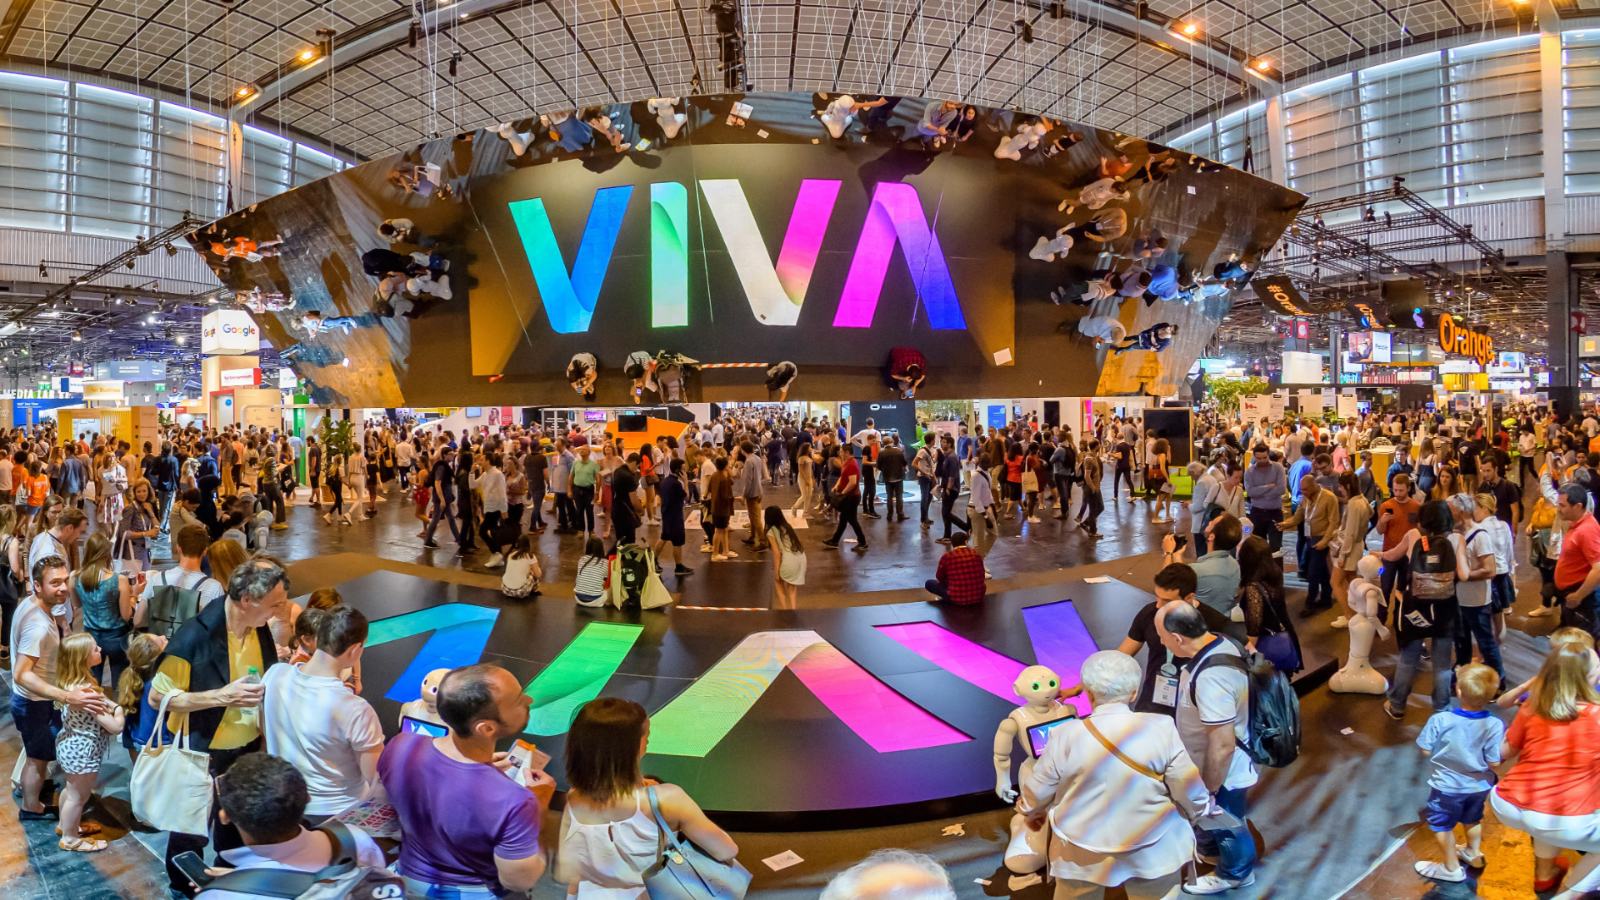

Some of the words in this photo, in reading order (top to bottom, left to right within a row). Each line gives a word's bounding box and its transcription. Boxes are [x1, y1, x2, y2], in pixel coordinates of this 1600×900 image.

[508, 179, 967, 334] VIVA
[222, 323, 256, 337] Google
[1439, 313, 1495, 365] Orange
